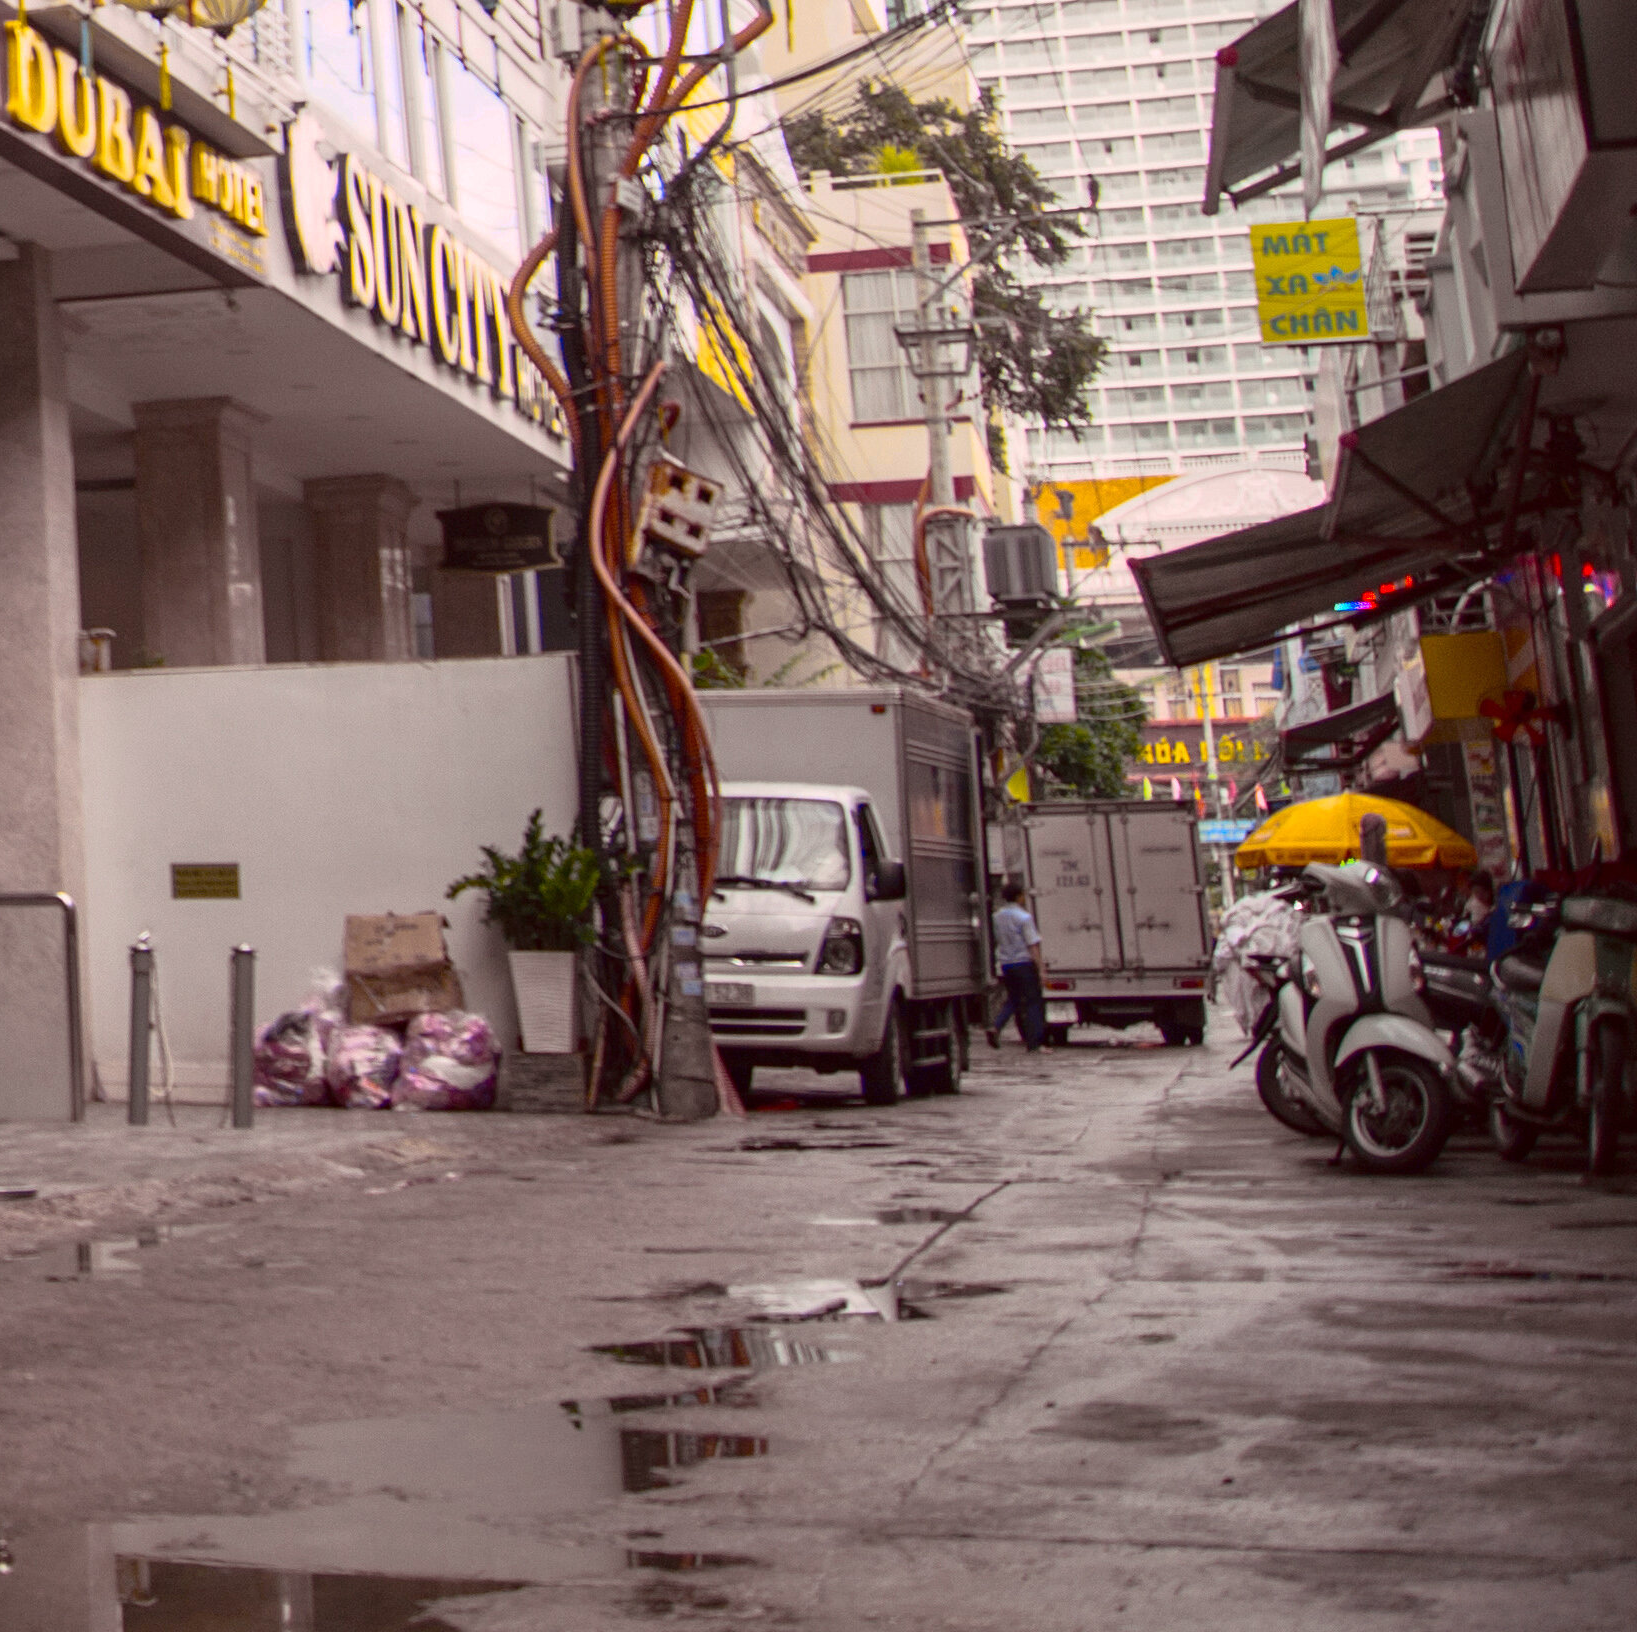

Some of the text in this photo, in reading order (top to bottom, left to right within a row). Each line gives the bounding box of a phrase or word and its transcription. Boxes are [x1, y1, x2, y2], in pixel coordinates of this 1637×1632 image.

[4, 19, 270, 238] DUBAI HOTEL
[1261, 226, 1330, 257] MÁT
[1264, 273, 1309, 297] XA
[1269, 306, 1360, 336] CHÂN
